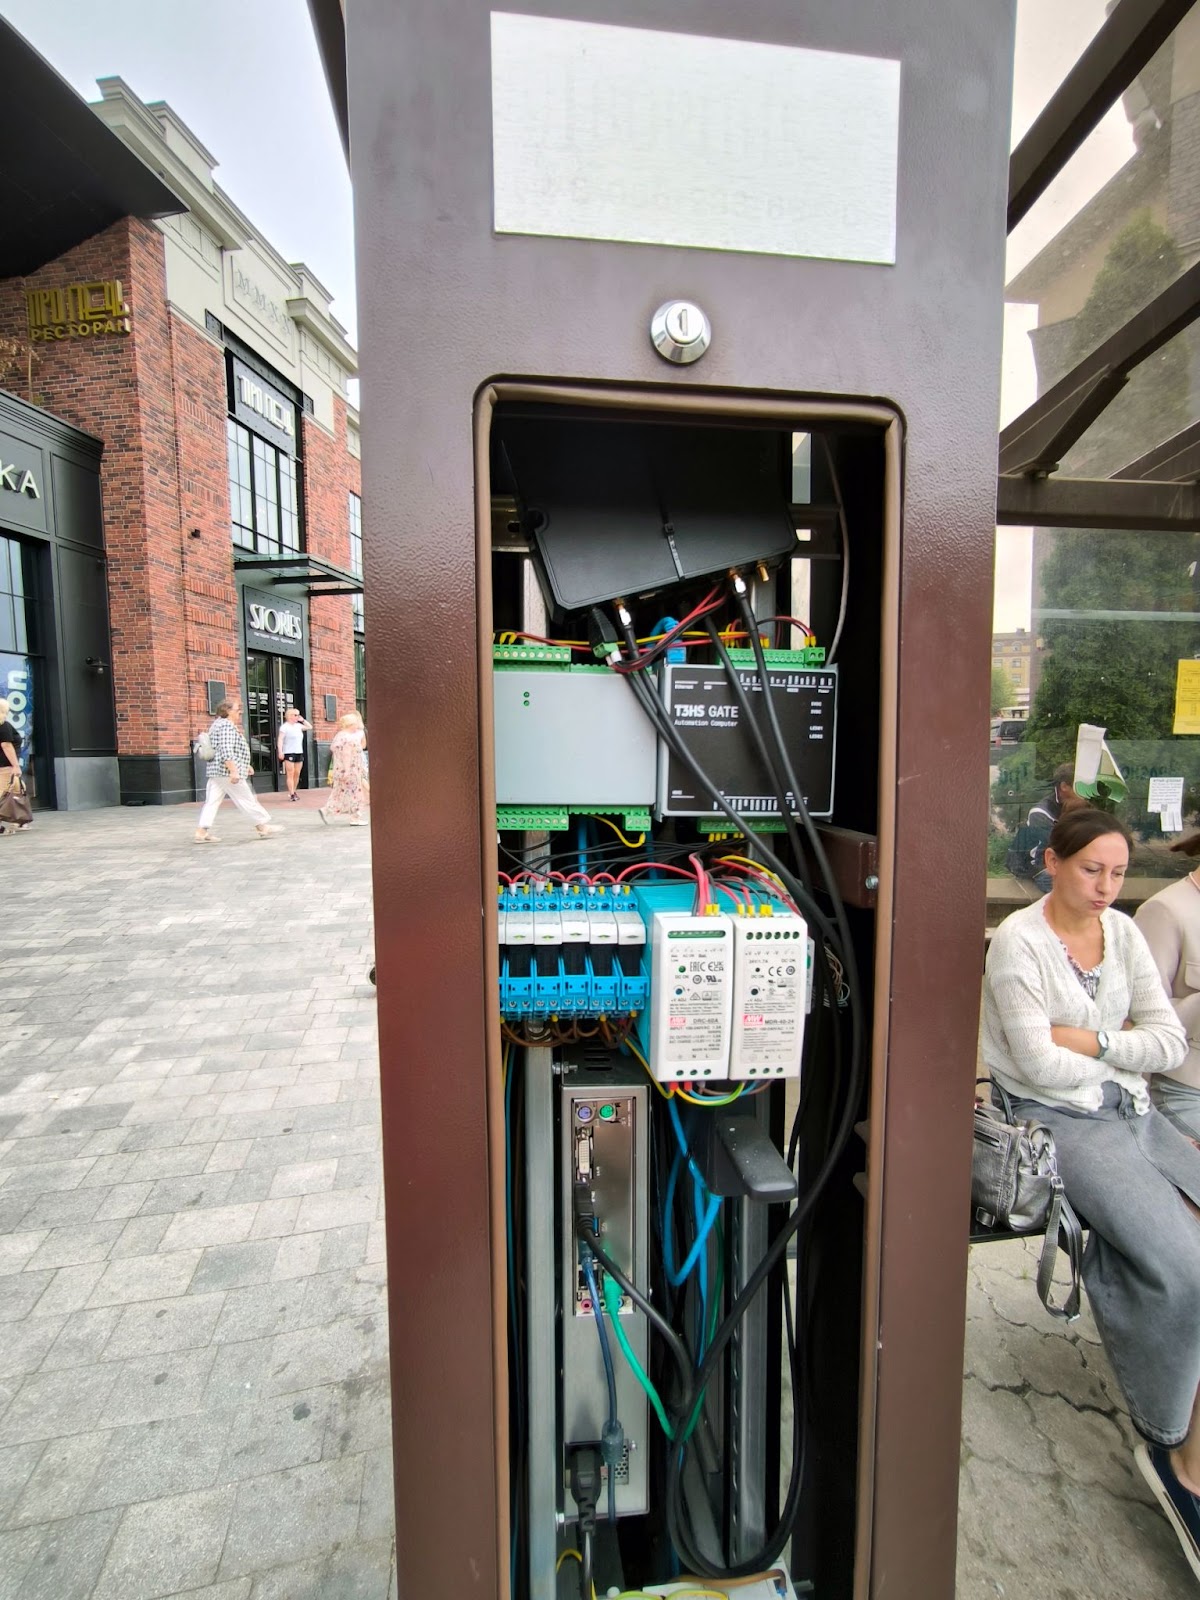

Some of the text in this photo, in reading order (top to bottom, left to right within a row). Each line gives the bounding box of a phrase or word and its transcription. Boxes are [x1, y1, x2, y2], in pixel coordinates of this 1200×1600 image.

[30, 317, 132, 342] РЕСТОРАН
[249, 603, 302, 640] STORIES
[674, 704, 740, 719] T3HS GATE
[674, 719, 738, 728] Automation Computer
